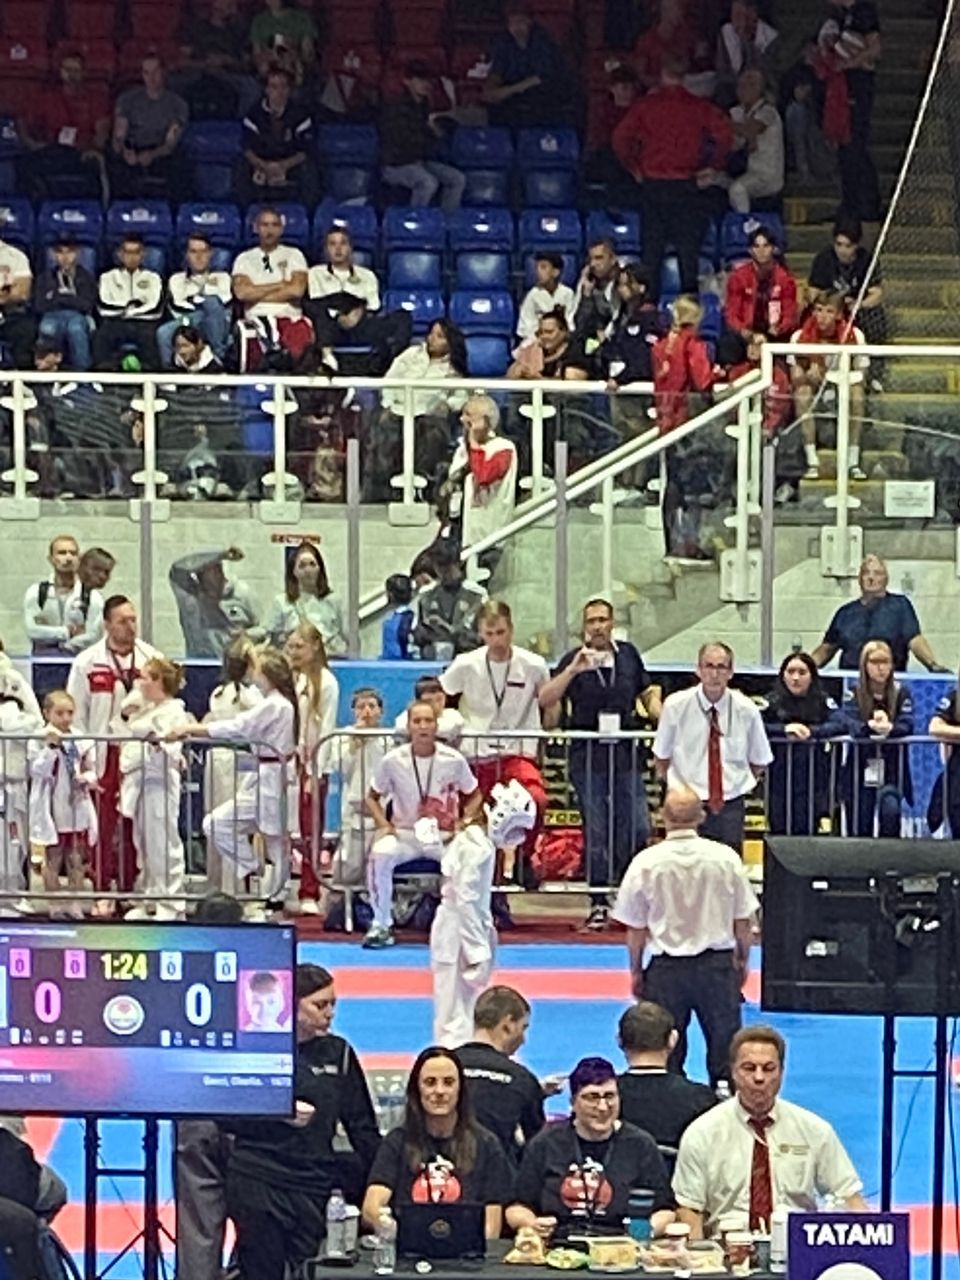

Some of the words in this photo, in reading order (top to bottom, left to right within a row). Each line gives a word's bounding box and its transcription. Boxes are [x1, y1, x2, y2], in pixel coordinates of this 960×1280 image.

[101, 953, 148, 980] 1:24
[34, 981, 61, 1023] 0
[185, 983, 212, 1026] 0
[803, 1223, 894, 1246] TATAMI
